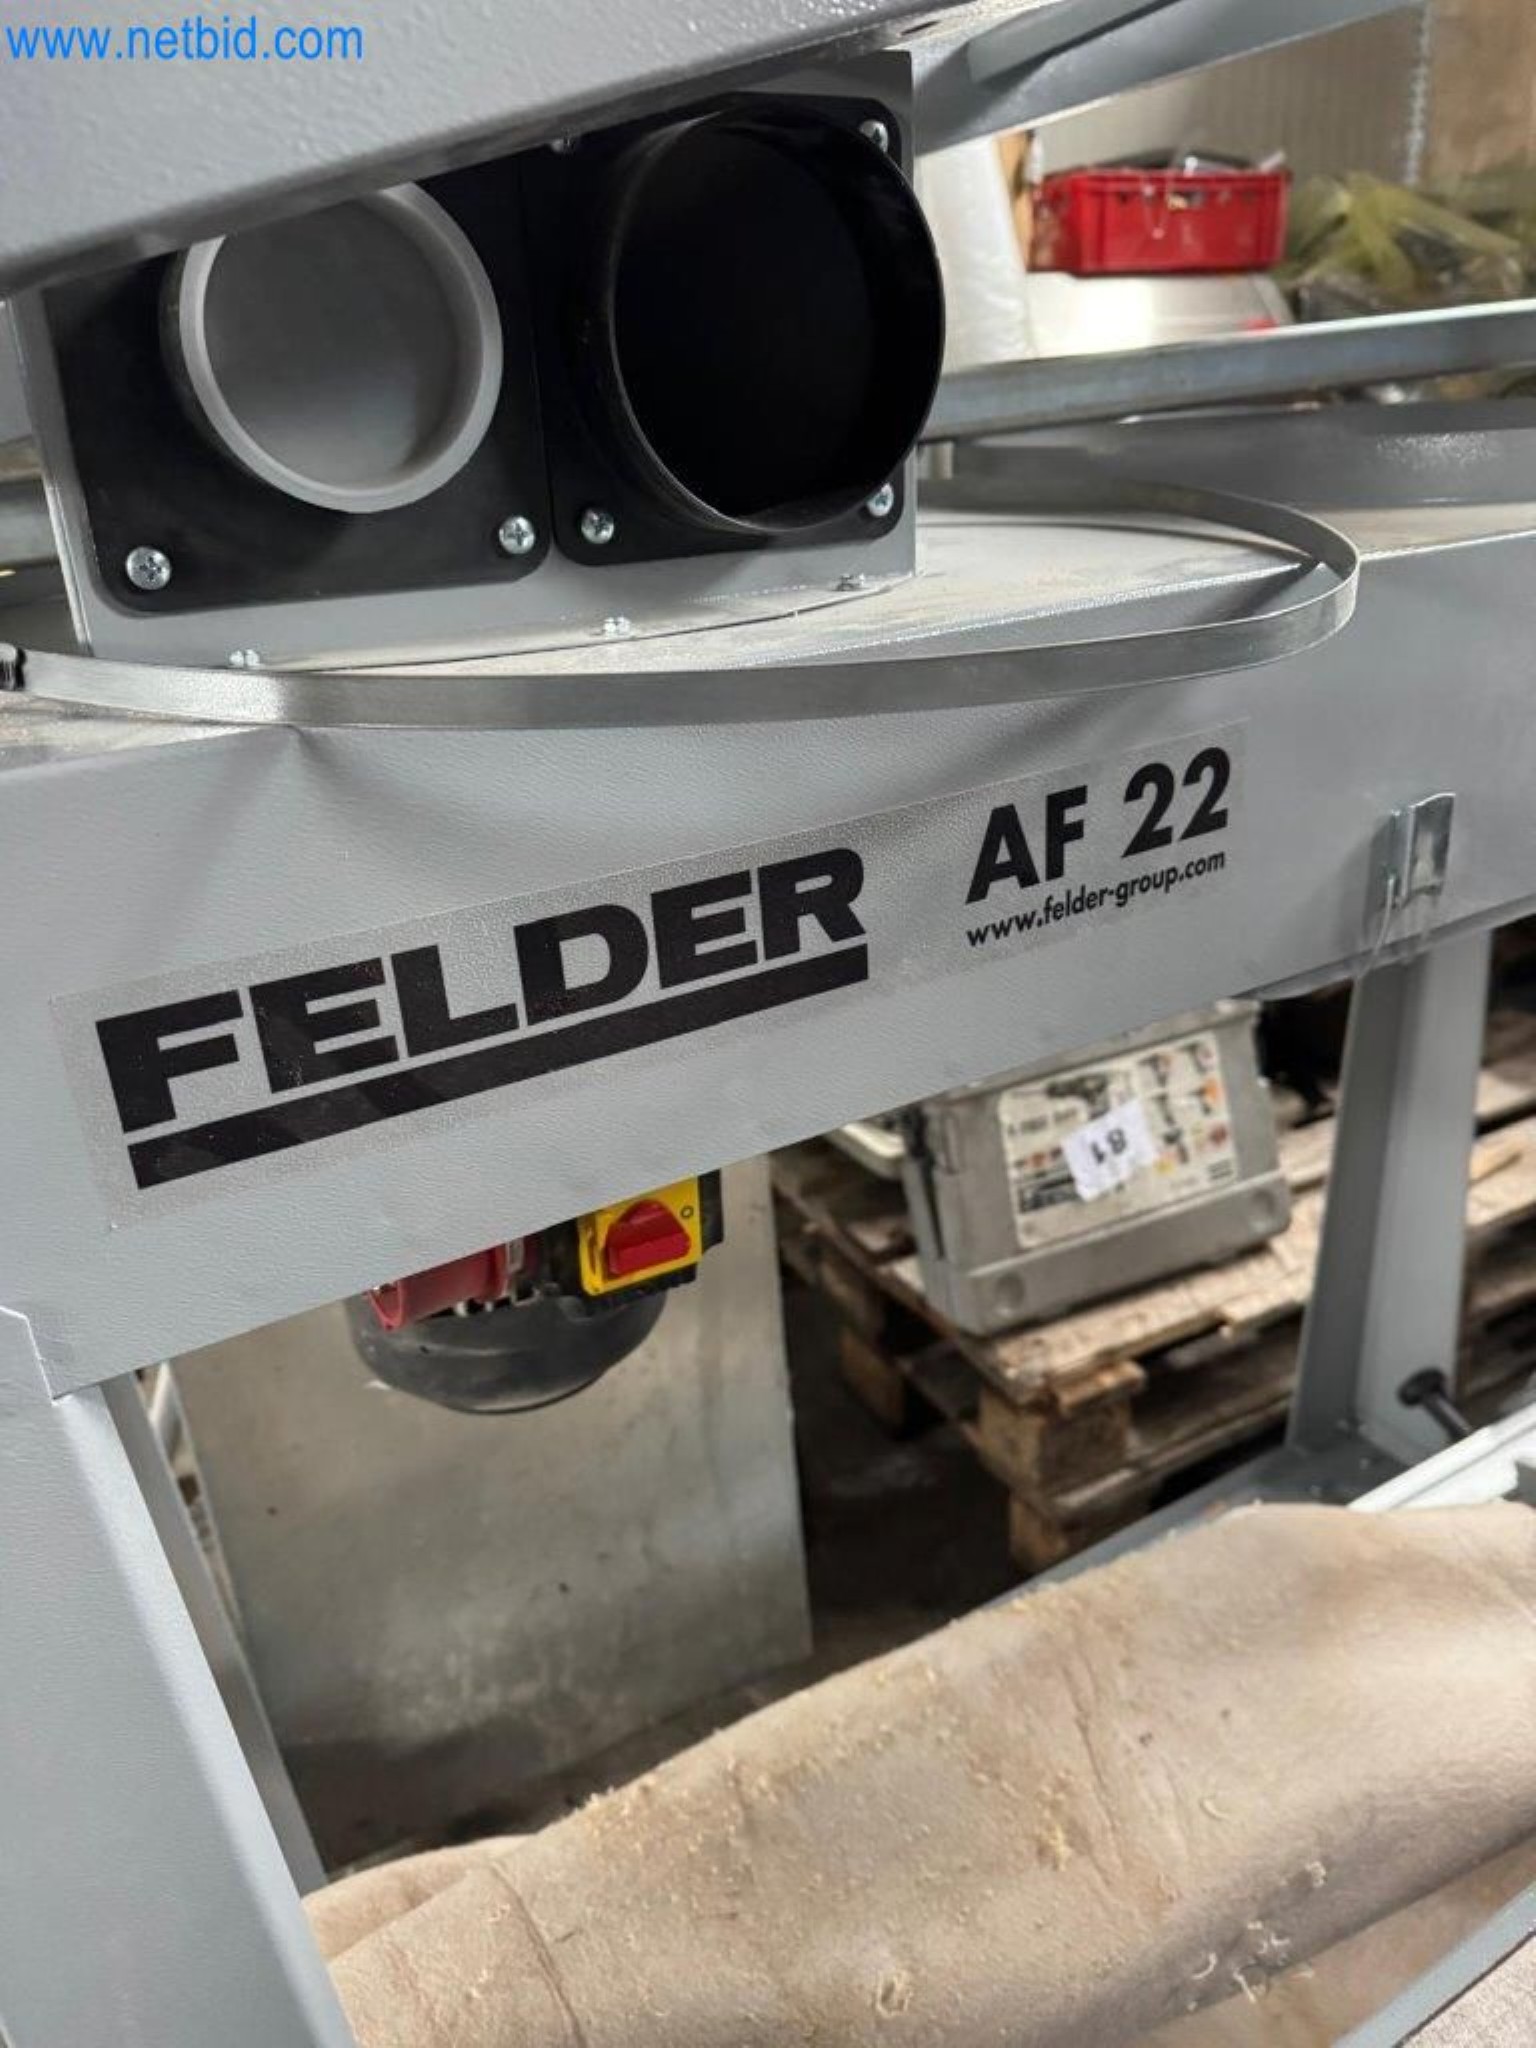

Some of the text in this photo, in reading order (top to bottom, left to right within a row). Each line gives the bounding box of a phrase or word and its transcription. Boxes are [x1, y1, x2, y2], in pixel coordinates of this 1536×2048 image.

[965, 747, 1231, 905] AF 22
[966, 851, 1225, 947] www.felder-group.com
[95, 847, 867, 1134] FELDER
